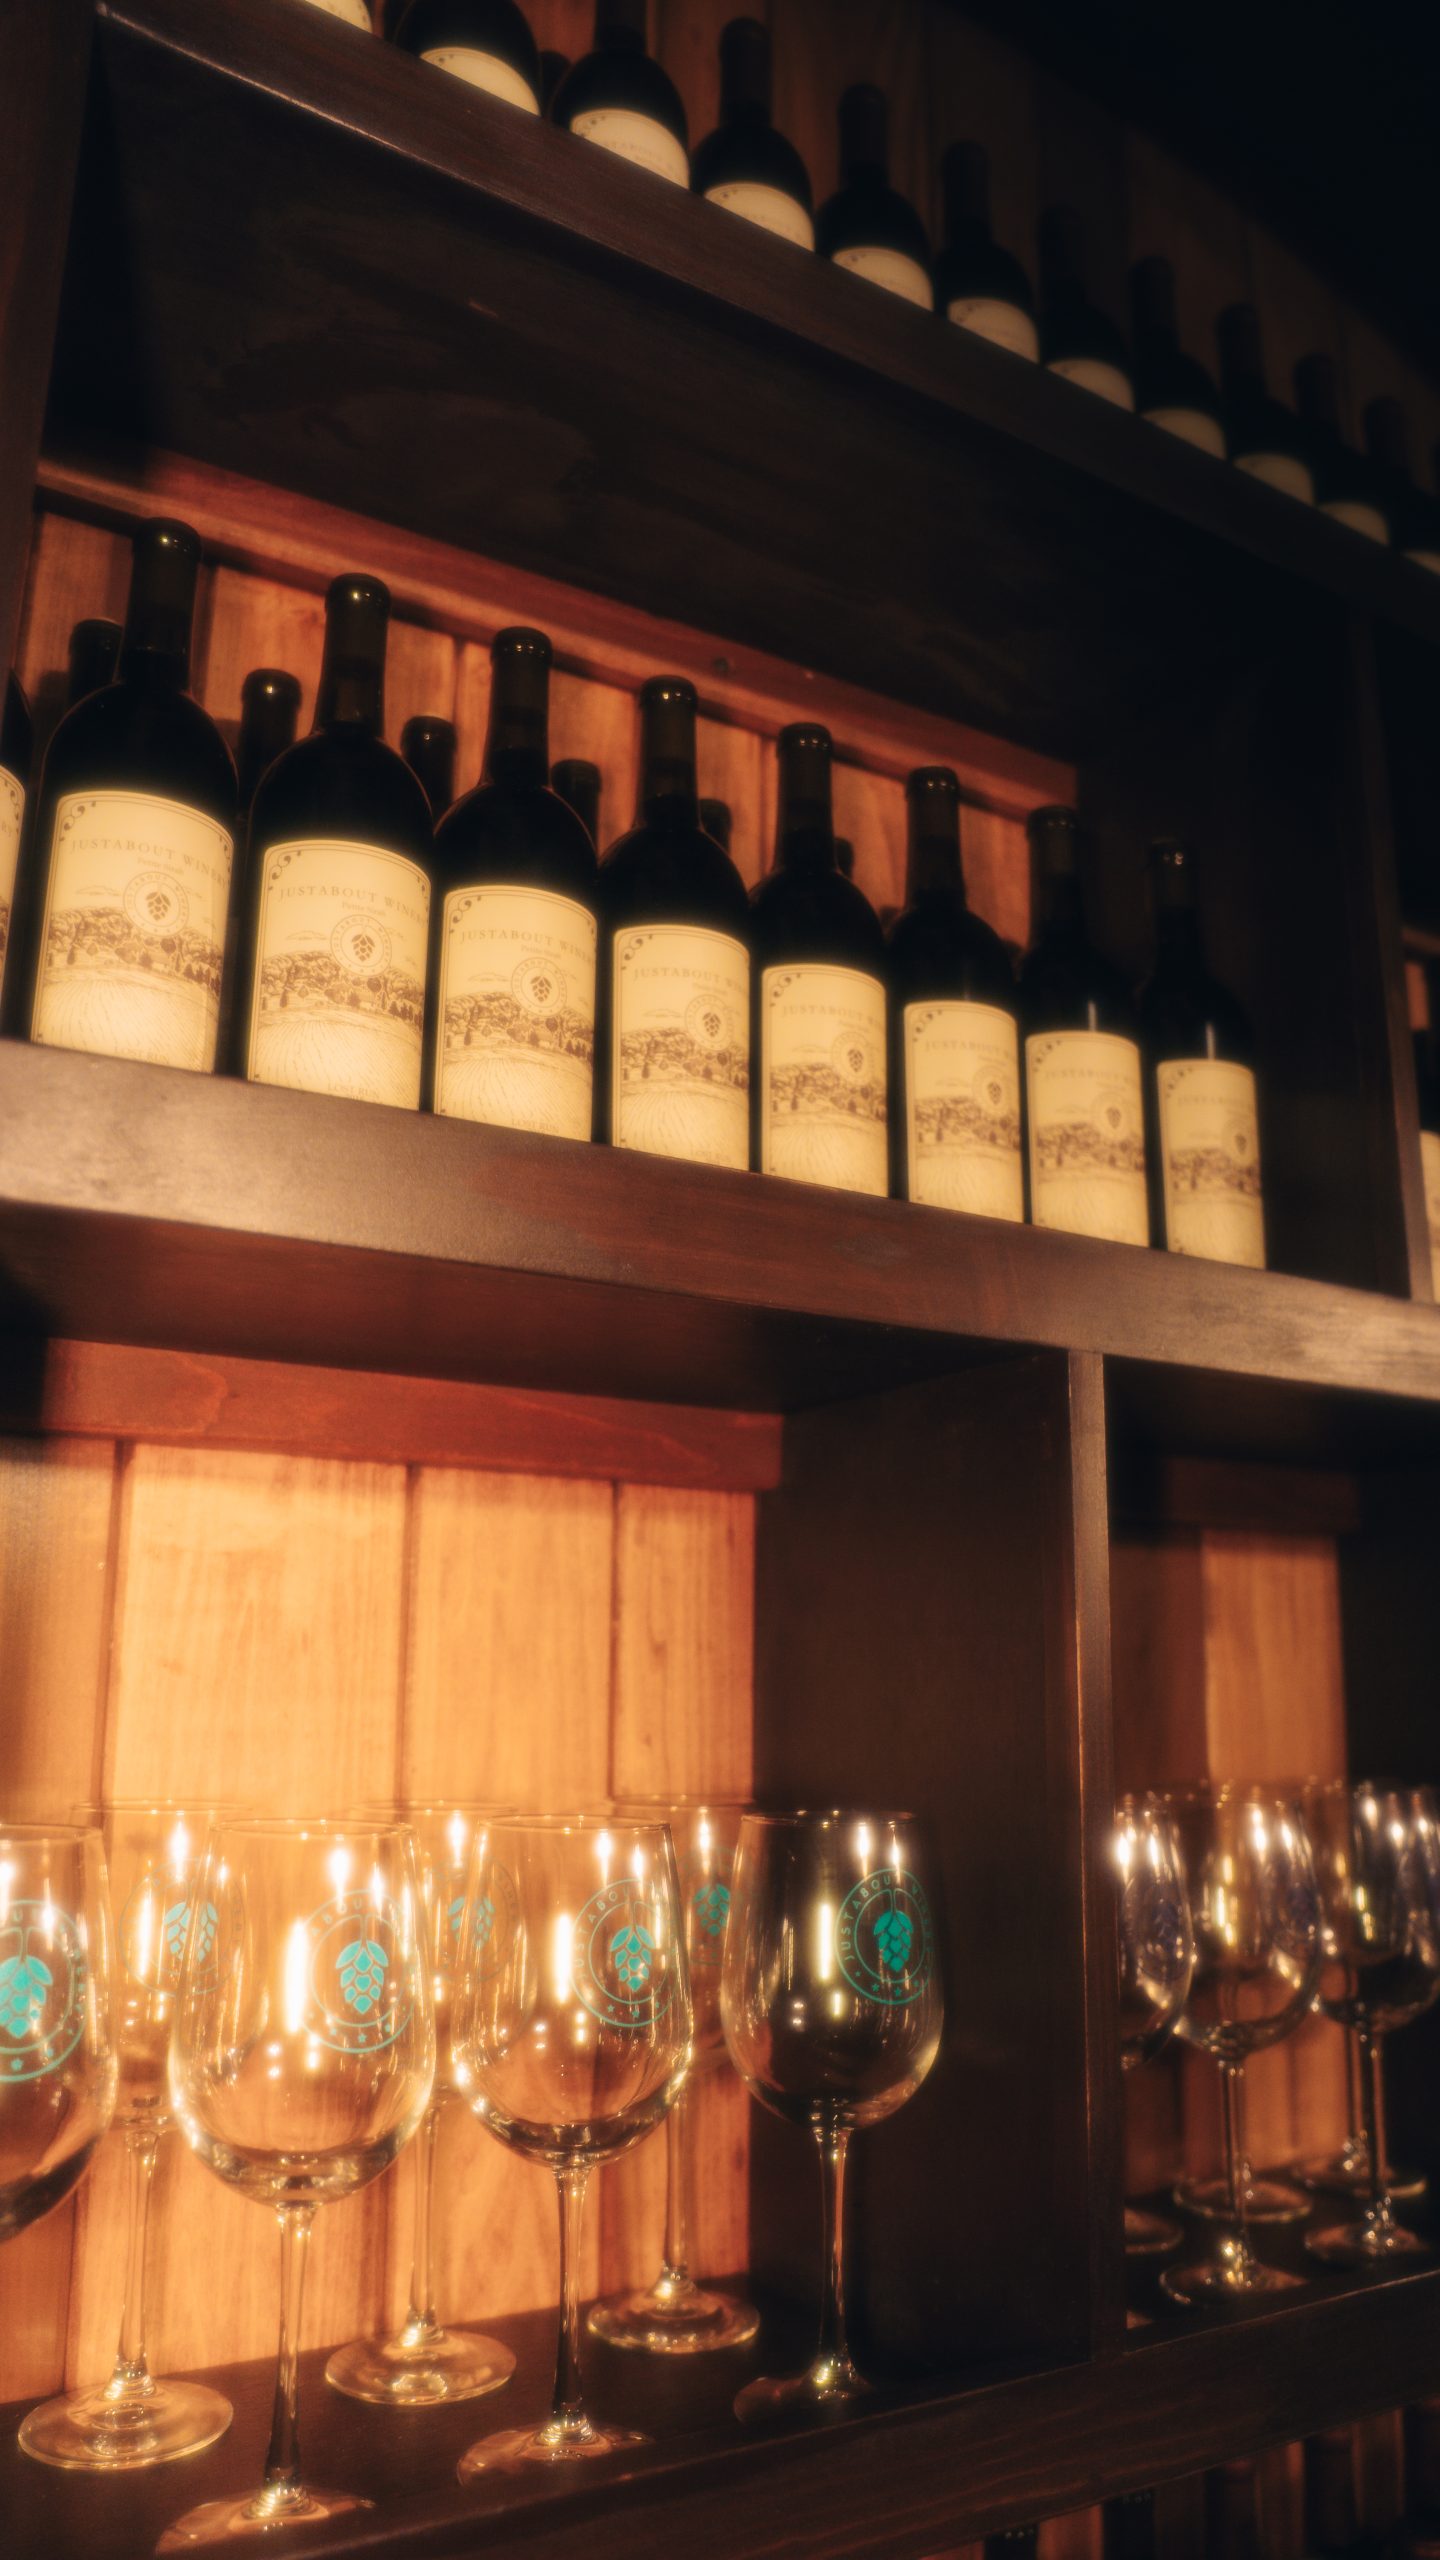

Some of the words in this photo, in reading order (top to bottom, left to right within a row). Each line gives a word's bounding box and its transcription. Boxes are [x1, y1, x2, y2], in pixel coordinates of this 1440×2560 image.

[71, 838, 177, 860] JUSTABOUT
[278, 885, 377, 903] JUSTABOUT
[459, 929, 553, 946] JUSTABOUT
[632, 966, 721, 984] JUSTABOUT
[841, 1874, 899, 1962] JUSTABOU
